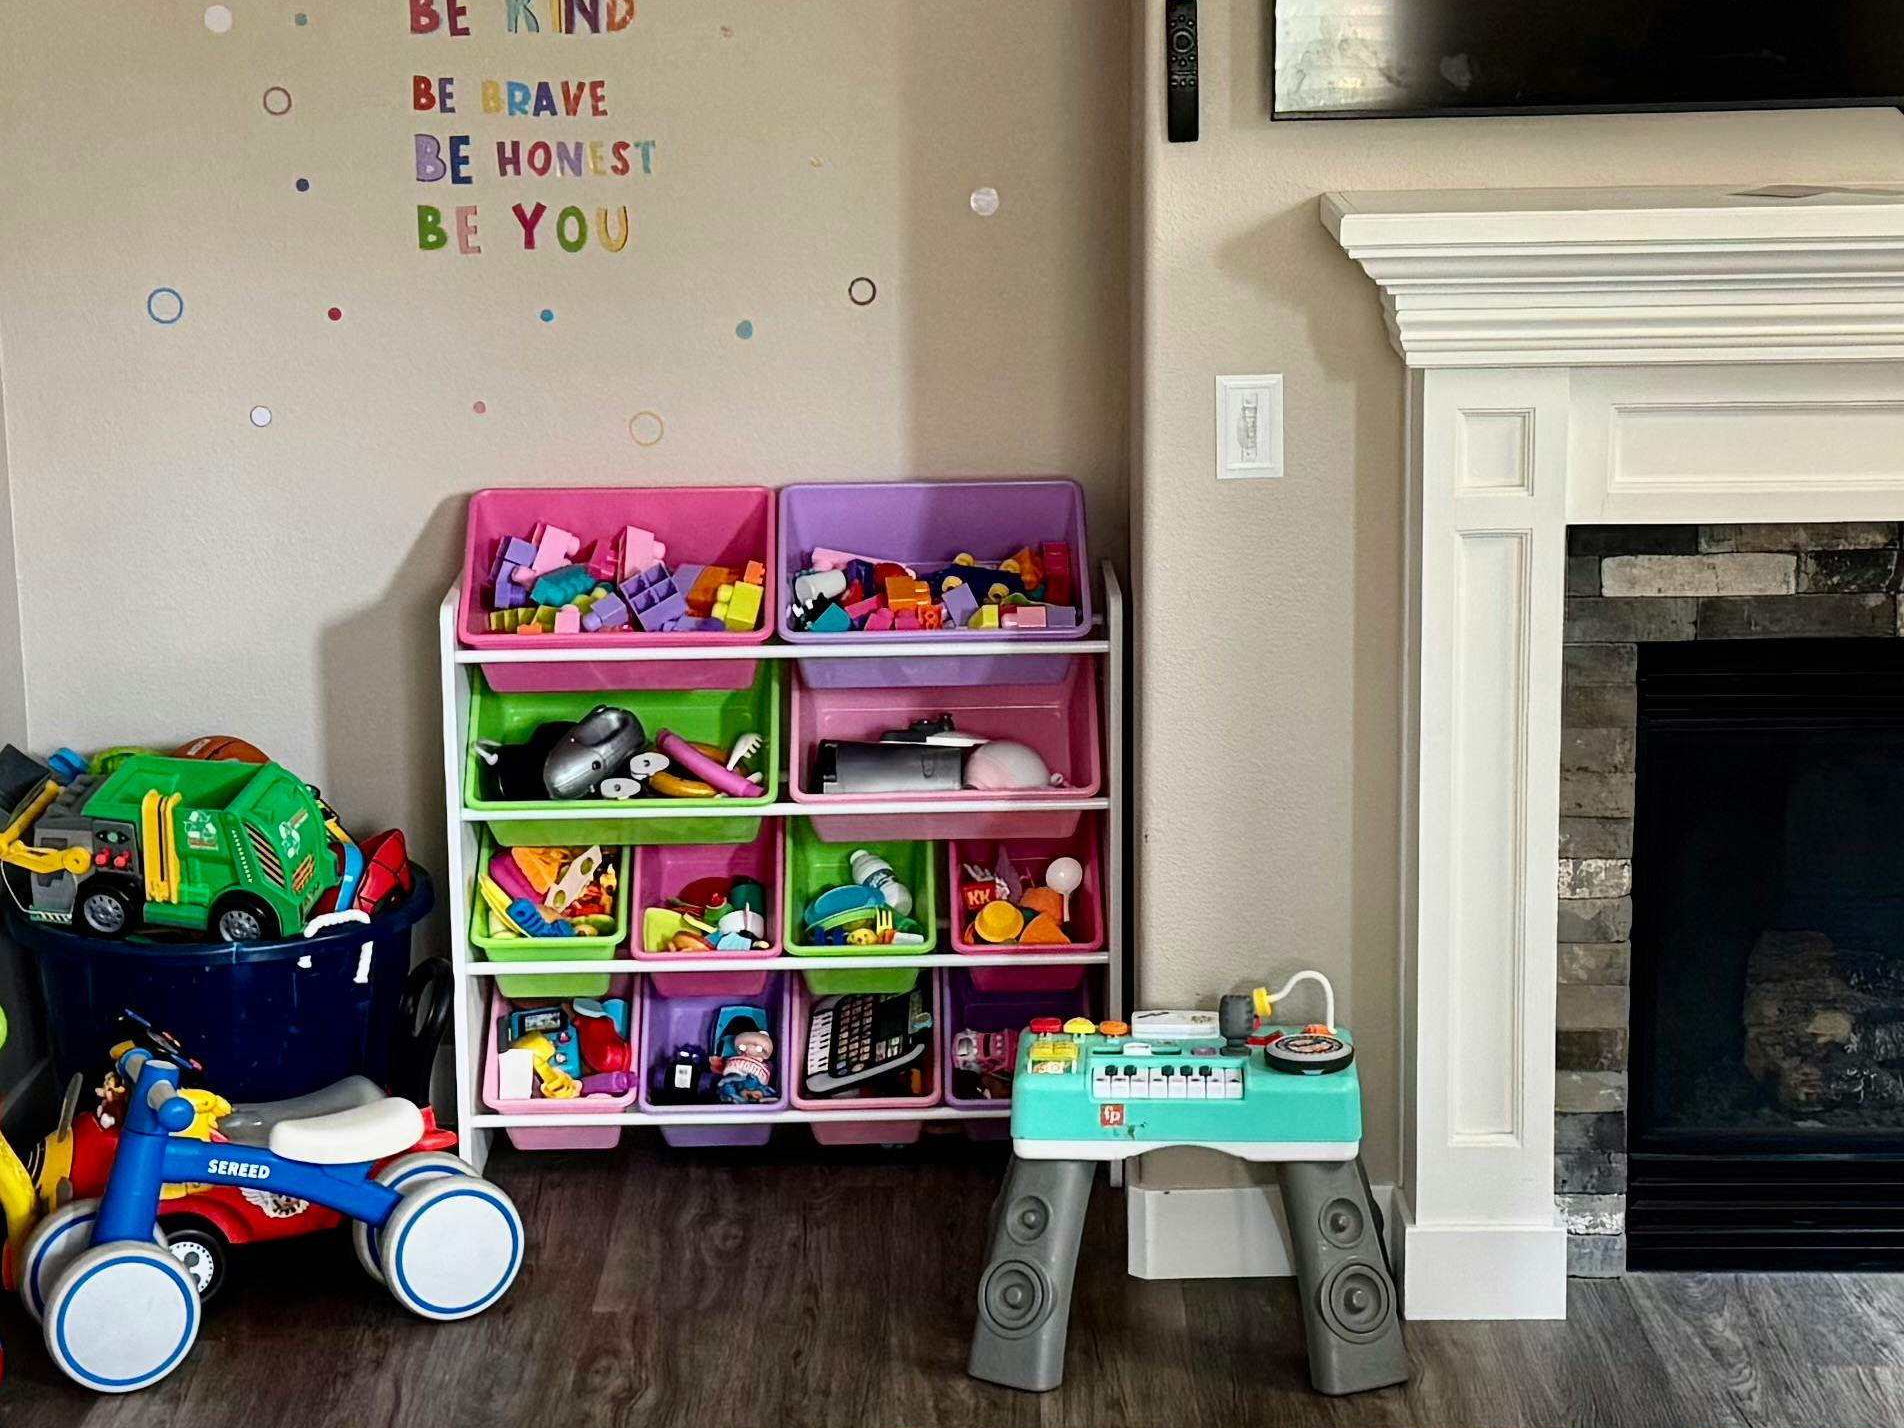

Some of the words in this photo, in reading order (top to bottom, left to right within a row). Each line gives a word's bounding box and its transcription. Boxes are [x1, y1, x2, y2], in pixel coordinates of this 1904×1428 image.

[412, 75, 456, 113] BE
[480, 79, 608, 117] BRAVE
[414, 133, 473, 184] BE
[496, 140, 656, 177] HONEST
[417, 204, 482, 254] BE
[511, 201, 629, 253] YOU
[1104, 1105, 1121, 1124] fp
[207, 1158, 271, 1180] SEREED
